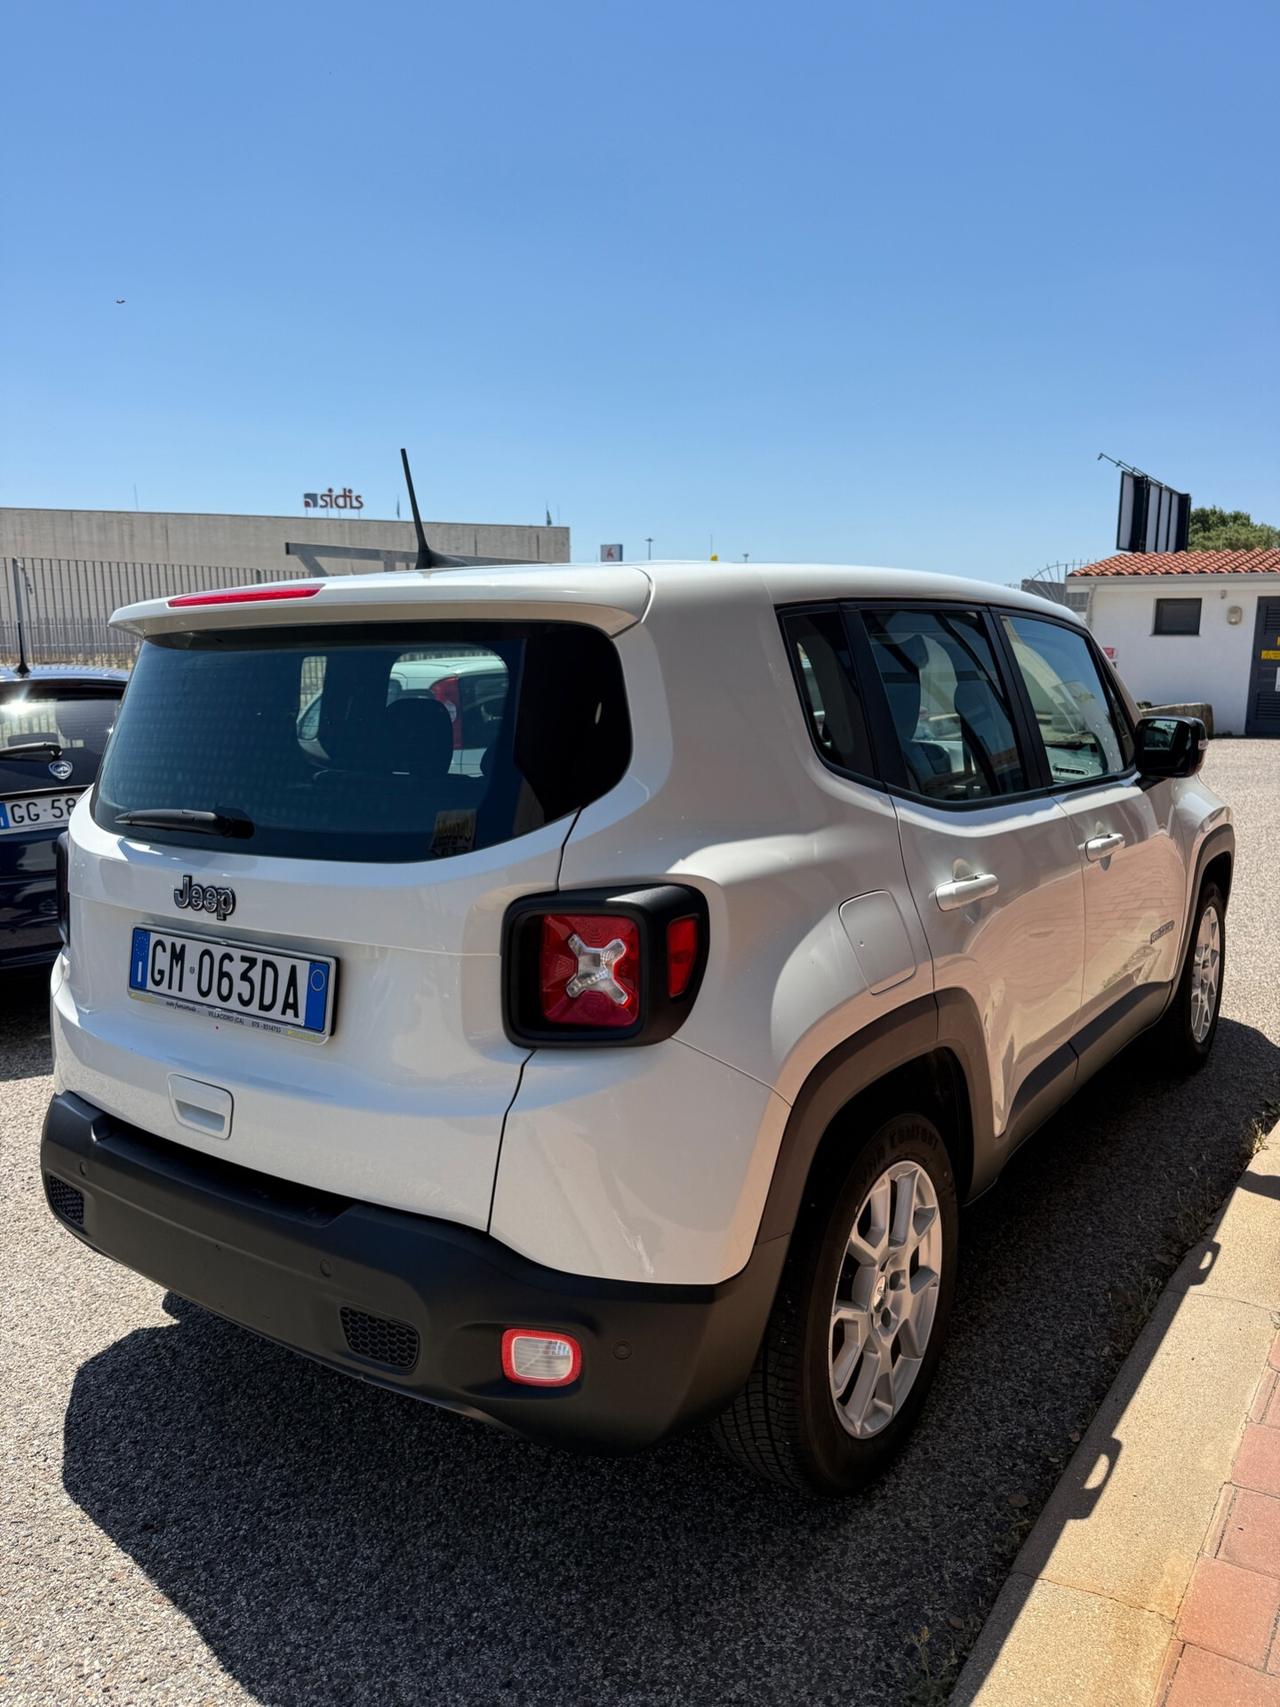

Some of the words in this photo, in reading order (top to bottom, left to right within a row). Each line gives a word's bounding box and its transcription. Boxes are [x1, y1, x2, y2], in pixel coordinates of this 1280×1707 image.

[319, 487, 364, 509] sidis
[10, 801, 41, 824] GG
[173, 875, 236, 921] Jeep
[150, 939, 186, 992] GM
[197, 948, 299, 1019] 063DA
